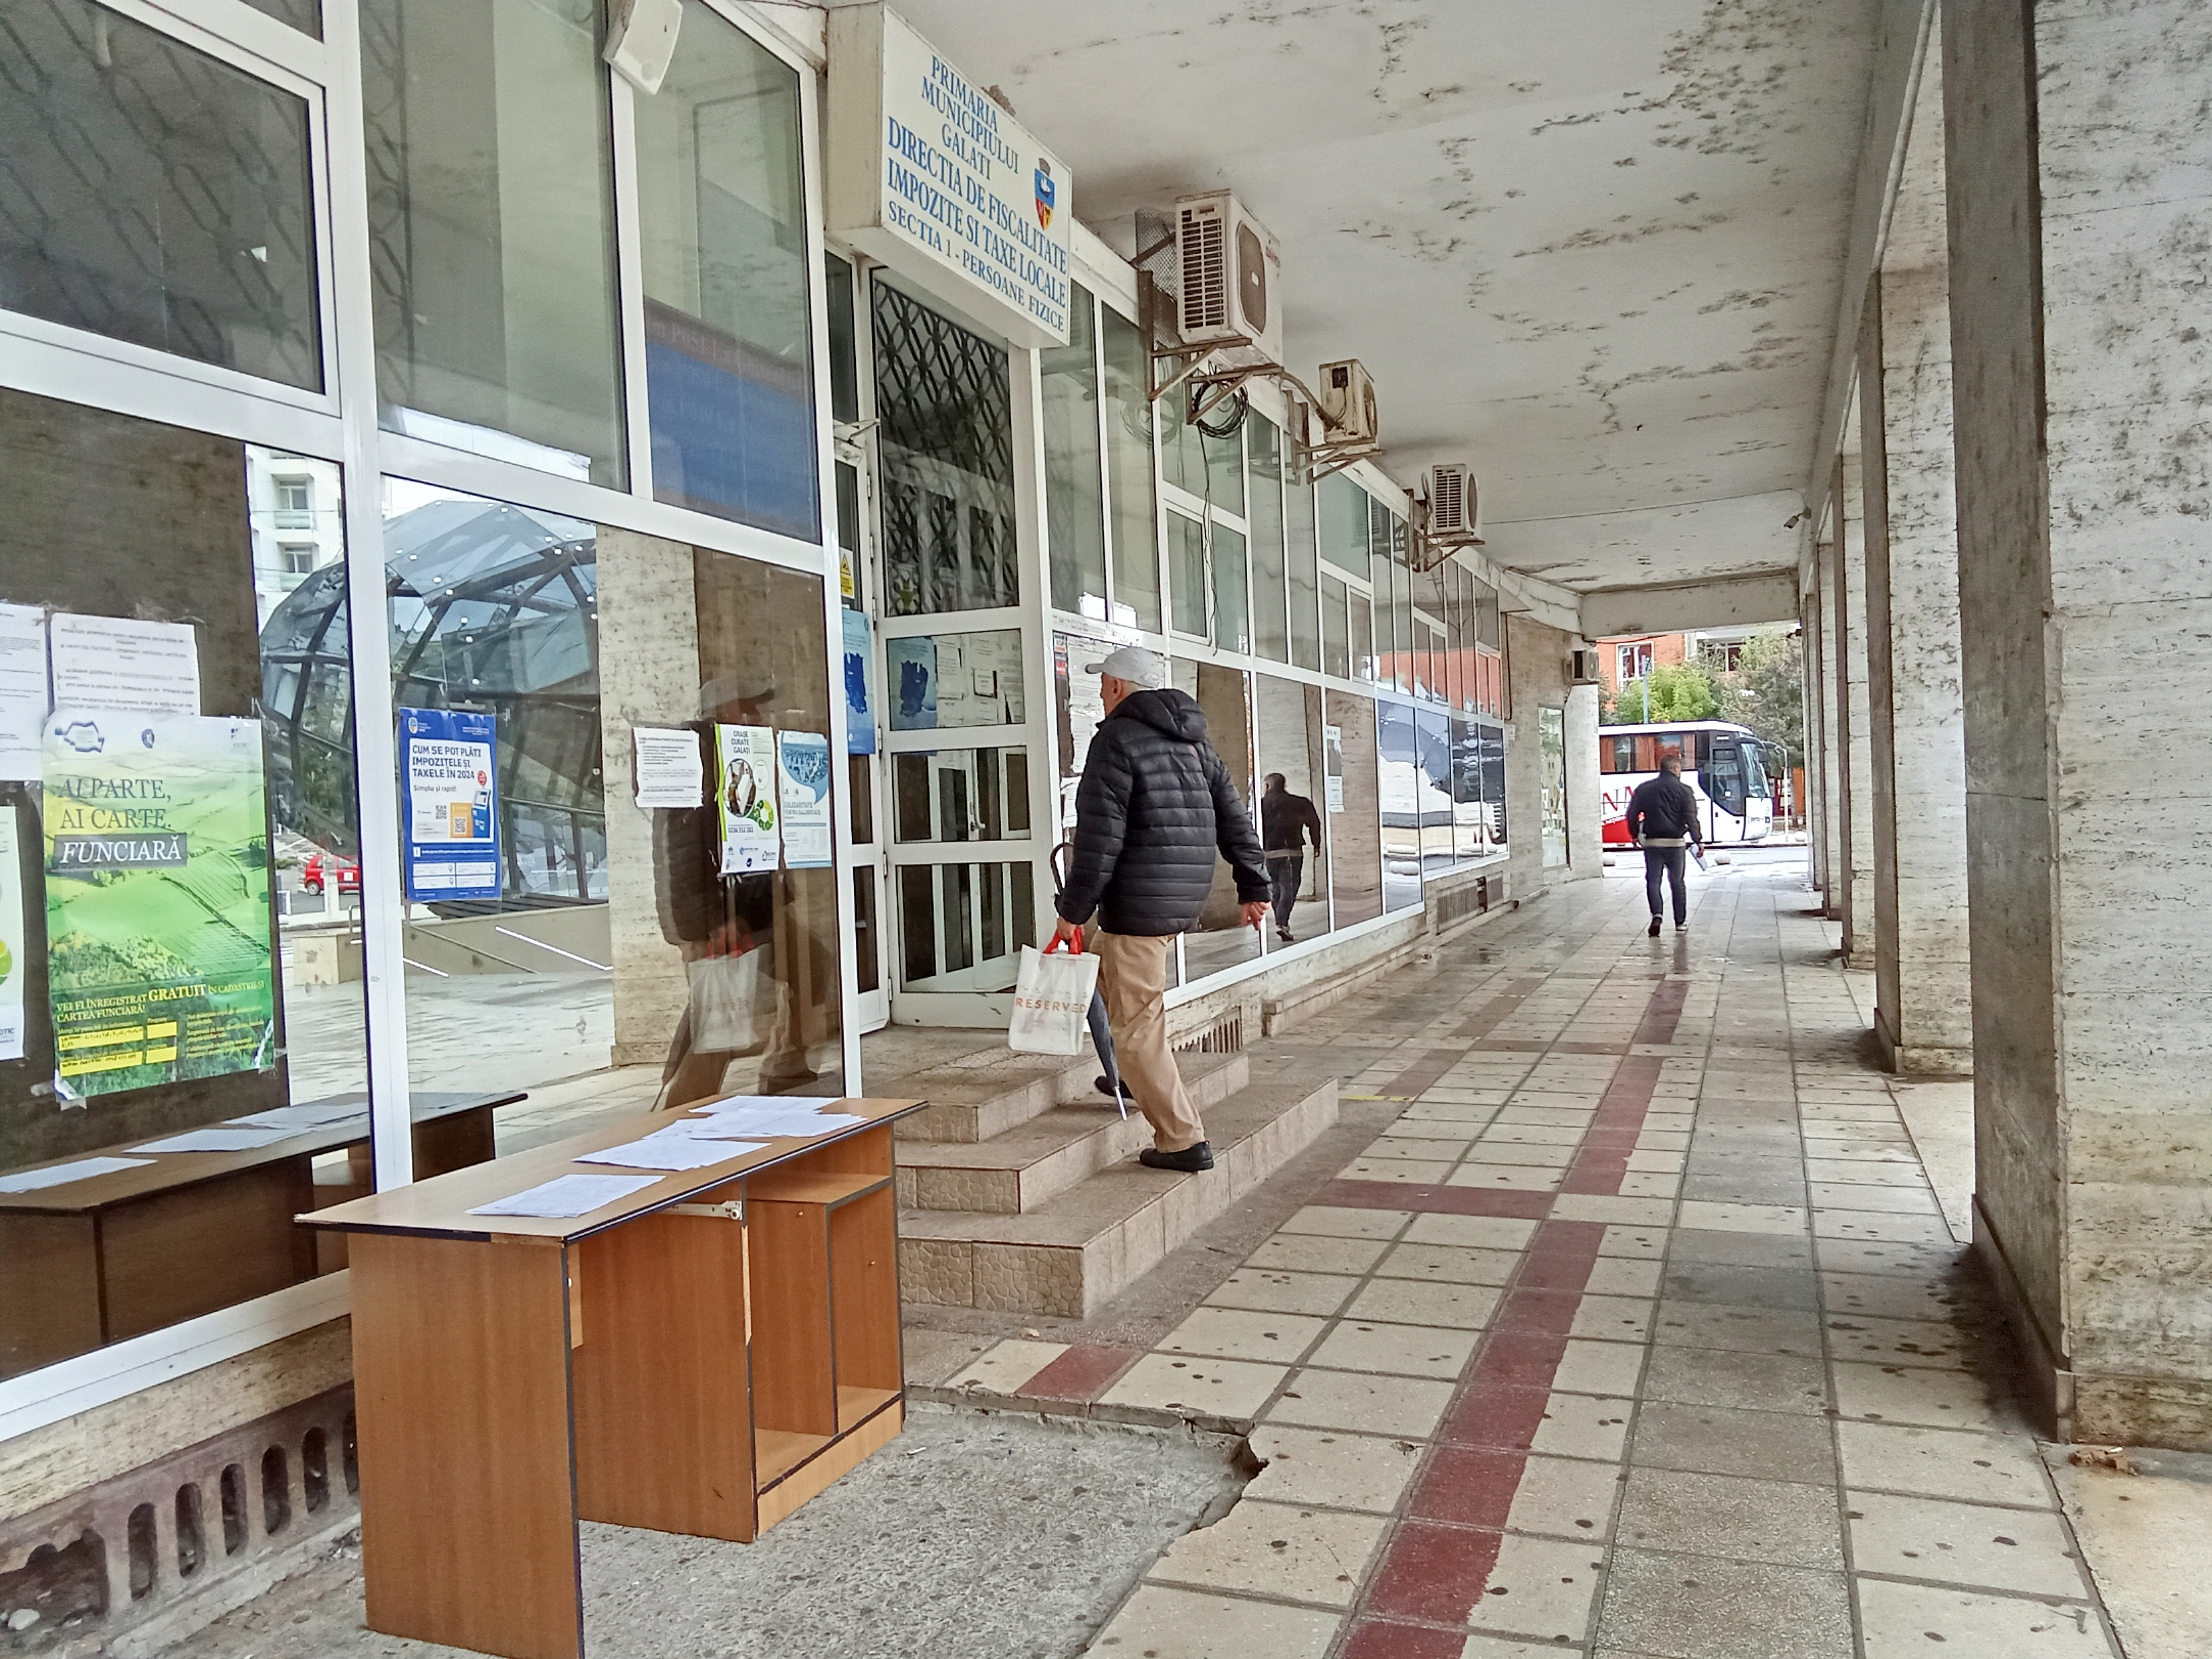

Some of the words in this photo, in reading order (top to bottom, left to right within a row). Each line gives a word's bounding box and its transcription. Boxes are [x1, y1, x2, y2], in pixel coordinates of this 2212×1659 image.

[931, 55, 998, 134] PRIMARIA
[922, 76, 1019, 174] MUNICIPIULUI
[942, 123, 991, 180] GALATI
[888, 116, 963, 197] DIRECTIA
[966, 175, 985, 214] DE
[989, 193, 1067, 274] FISCALITATE
[888, 157, 963, 236] IMPOZITE
[966, 214, 979, 247] SI
[983, 225, 1017, 274] TAXE
[1019, 253, 1065, 308] LOCALE
[888, 200, 942, 252] SECTIA
[946, 239, 951, 259] 1
[962, 248, 1025, 306] PERSOANE
[1029, 294, 1064, 333] FIZICE
[412, 756, 462, 767] IMPOZITELE
[413, 745, 430, 754] CUM
[431, 745, 443, 755] SE
[445, 746, 459, 756] POT
[412, 769, 445, 778] TAXELE
[457, 771, 475, 779] 2024
[58, 779, 86, 798] AI
[91, 779, 171, 802] PARTE,
[60, 808, 85, 829] AI
[91, 808, 172, 830] CARTE.
[60, 834, 182, 865] FUNCIARĂ
[57, 1002, 73, 1011] VEI
[75, 1000, 85, 1010] FI
[148, 984, 206, 1002] GRATUIT
[1015, 997, 1086, 1013] RESERVED
[57, 1009, 96, 1023] CARTEA
